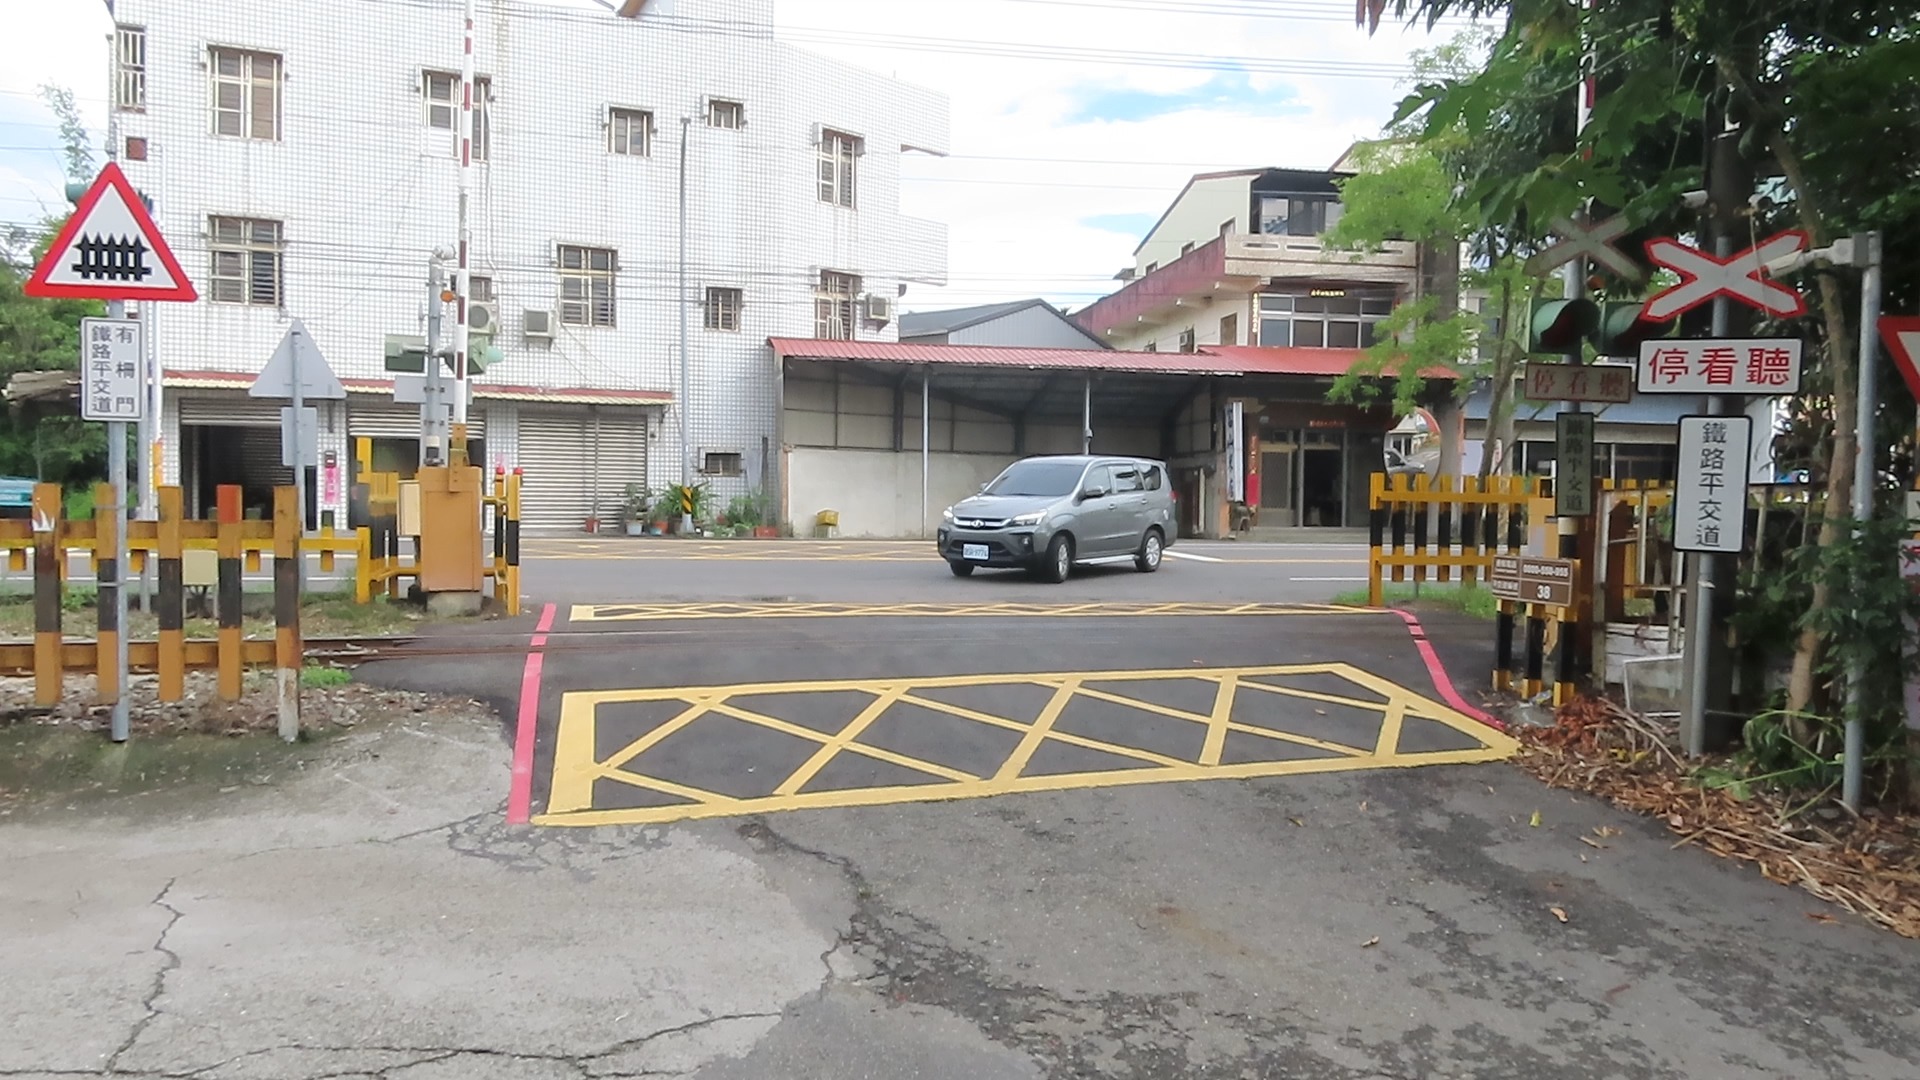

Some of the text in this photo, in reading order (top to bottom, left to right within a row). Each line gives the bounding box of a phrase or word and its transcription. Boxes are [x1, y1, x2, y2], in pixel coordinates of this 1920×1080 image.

[91, 325, 113, 413] 鐵路平交道
[115, 326, 136, 413] 有柵門
[1648, 347, 1791, 386] 停看聽
[1695, 421, 1728, 548] 鐵路平交道
[1536, 585, 1551, 600] 38
